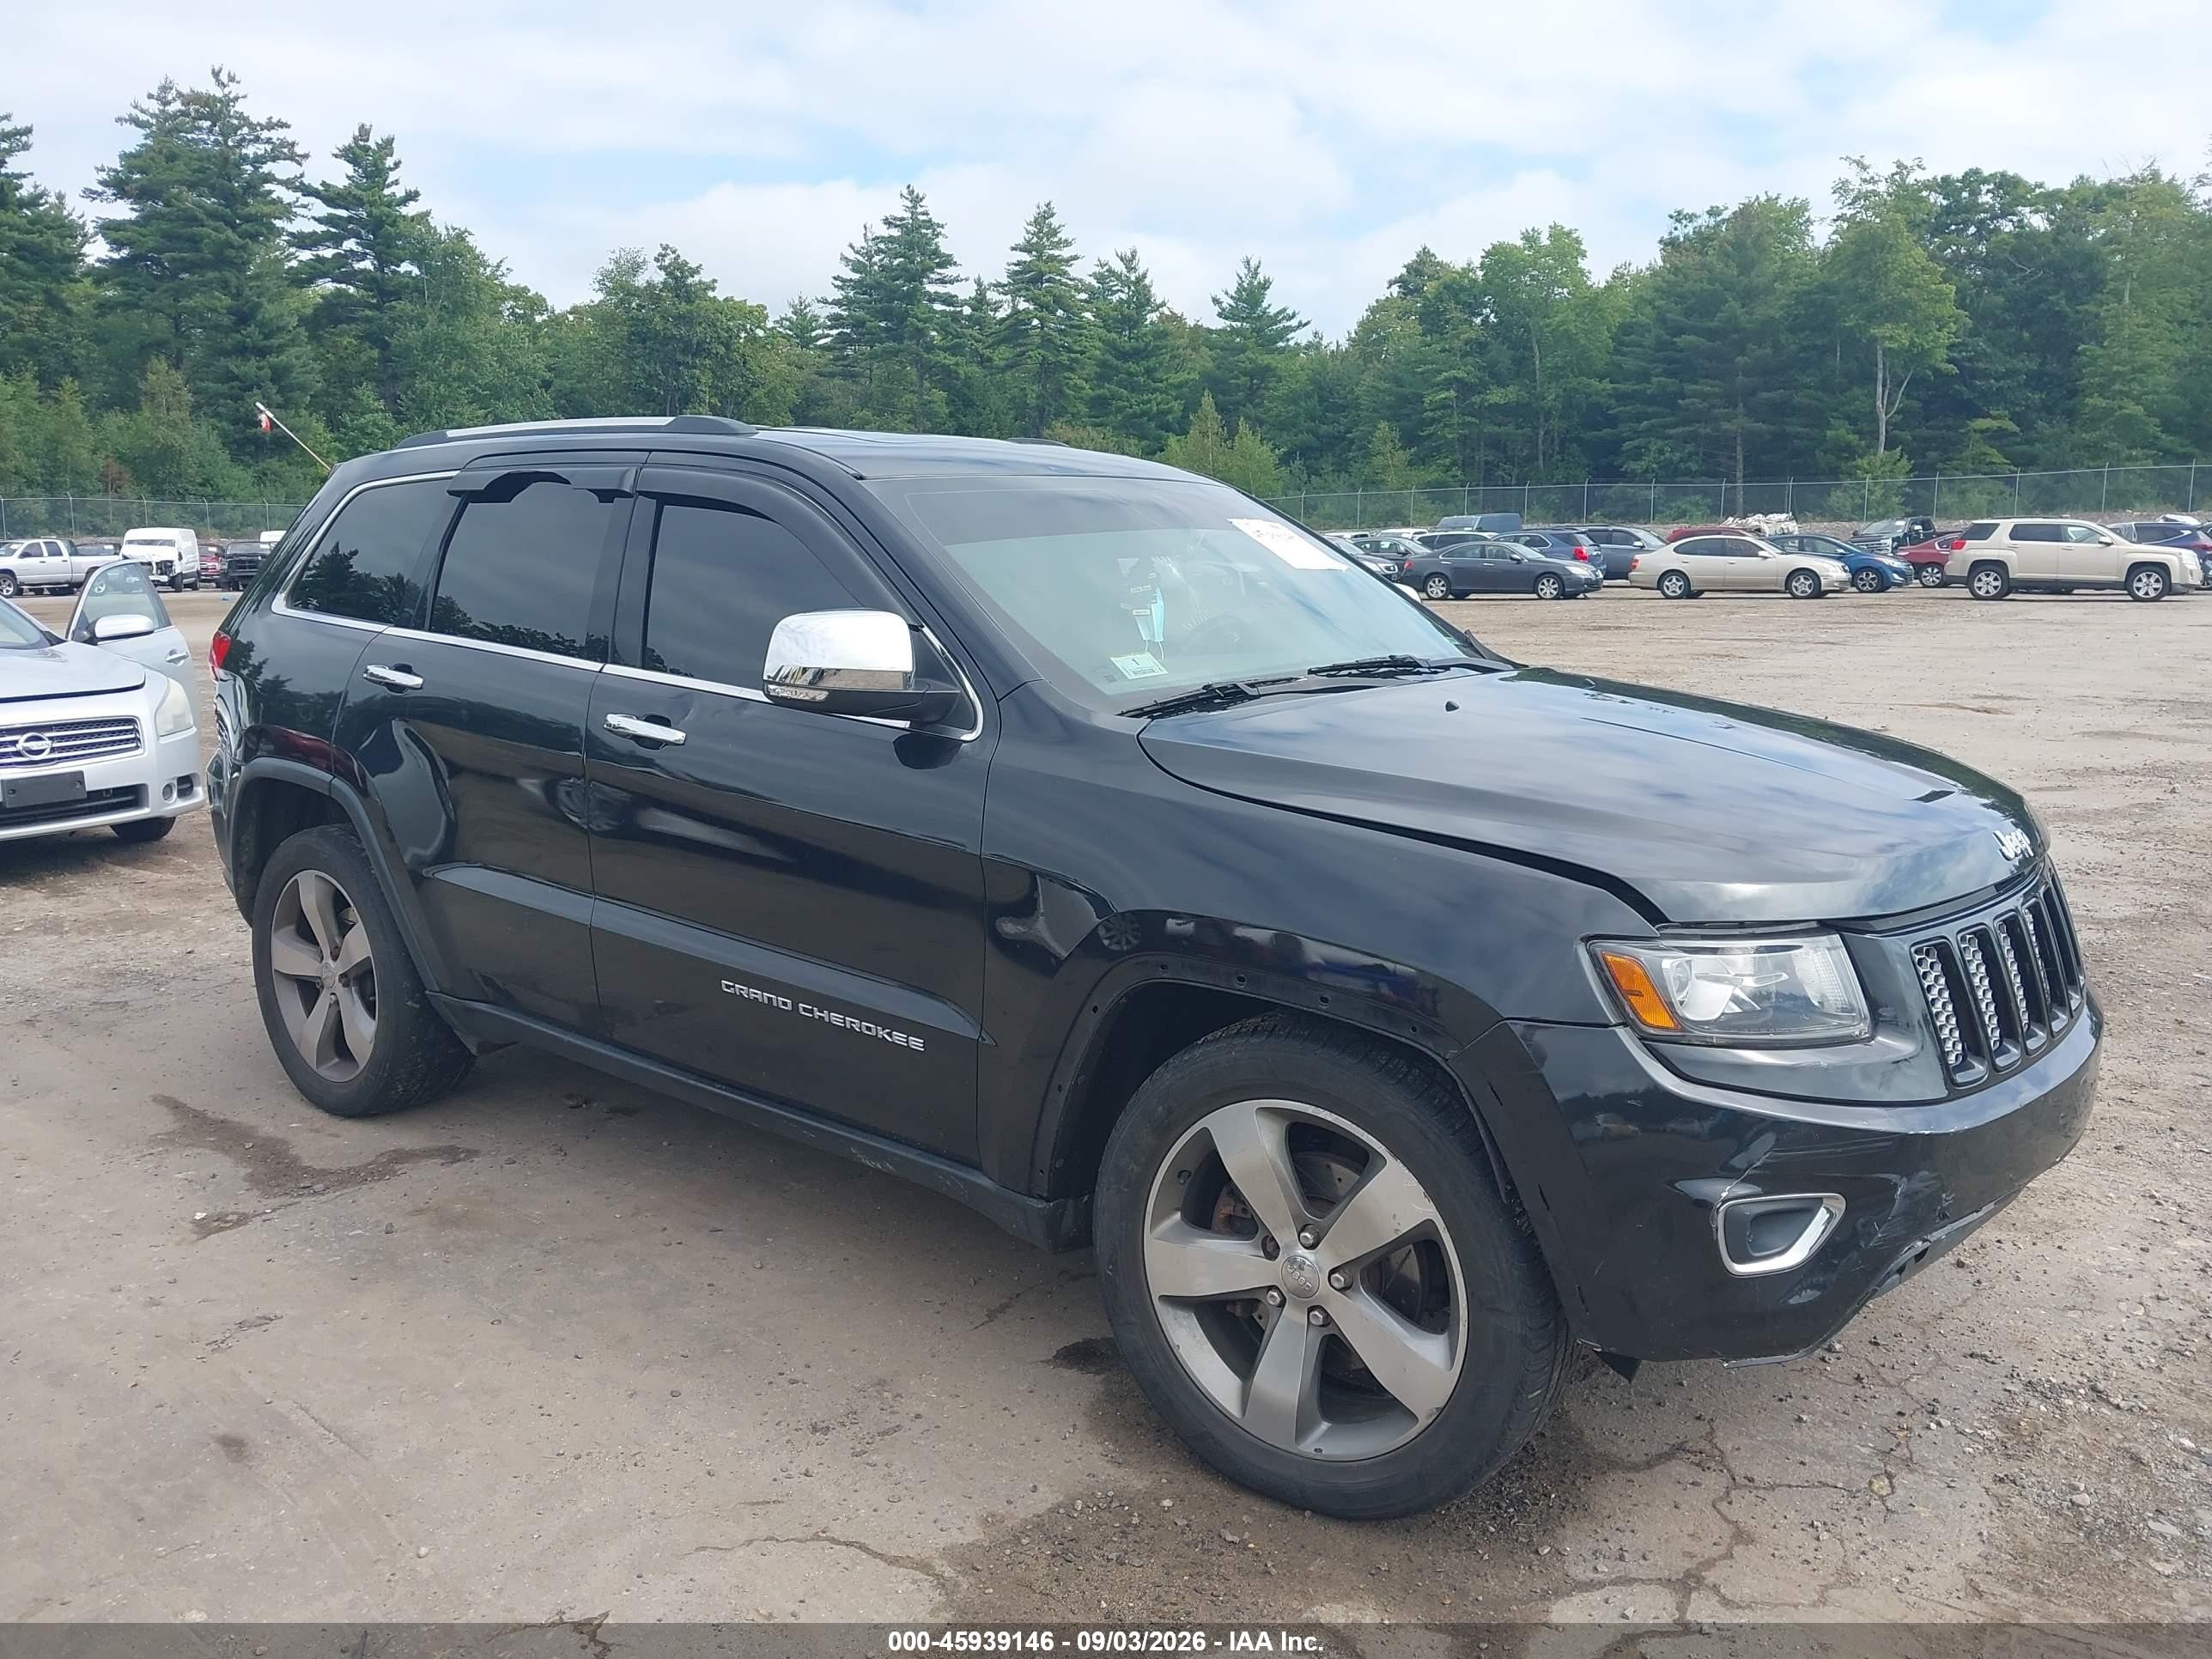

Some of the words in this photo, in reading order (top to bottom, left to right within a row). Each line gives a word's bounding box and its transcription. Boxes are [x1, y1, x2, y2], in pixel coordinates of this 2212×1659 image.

[720, 980, 793, 1011] GRAND
[798, 1002, 925, 1052] CHEROKEE
[1286, 1264, 1313, 1291] Jeep
